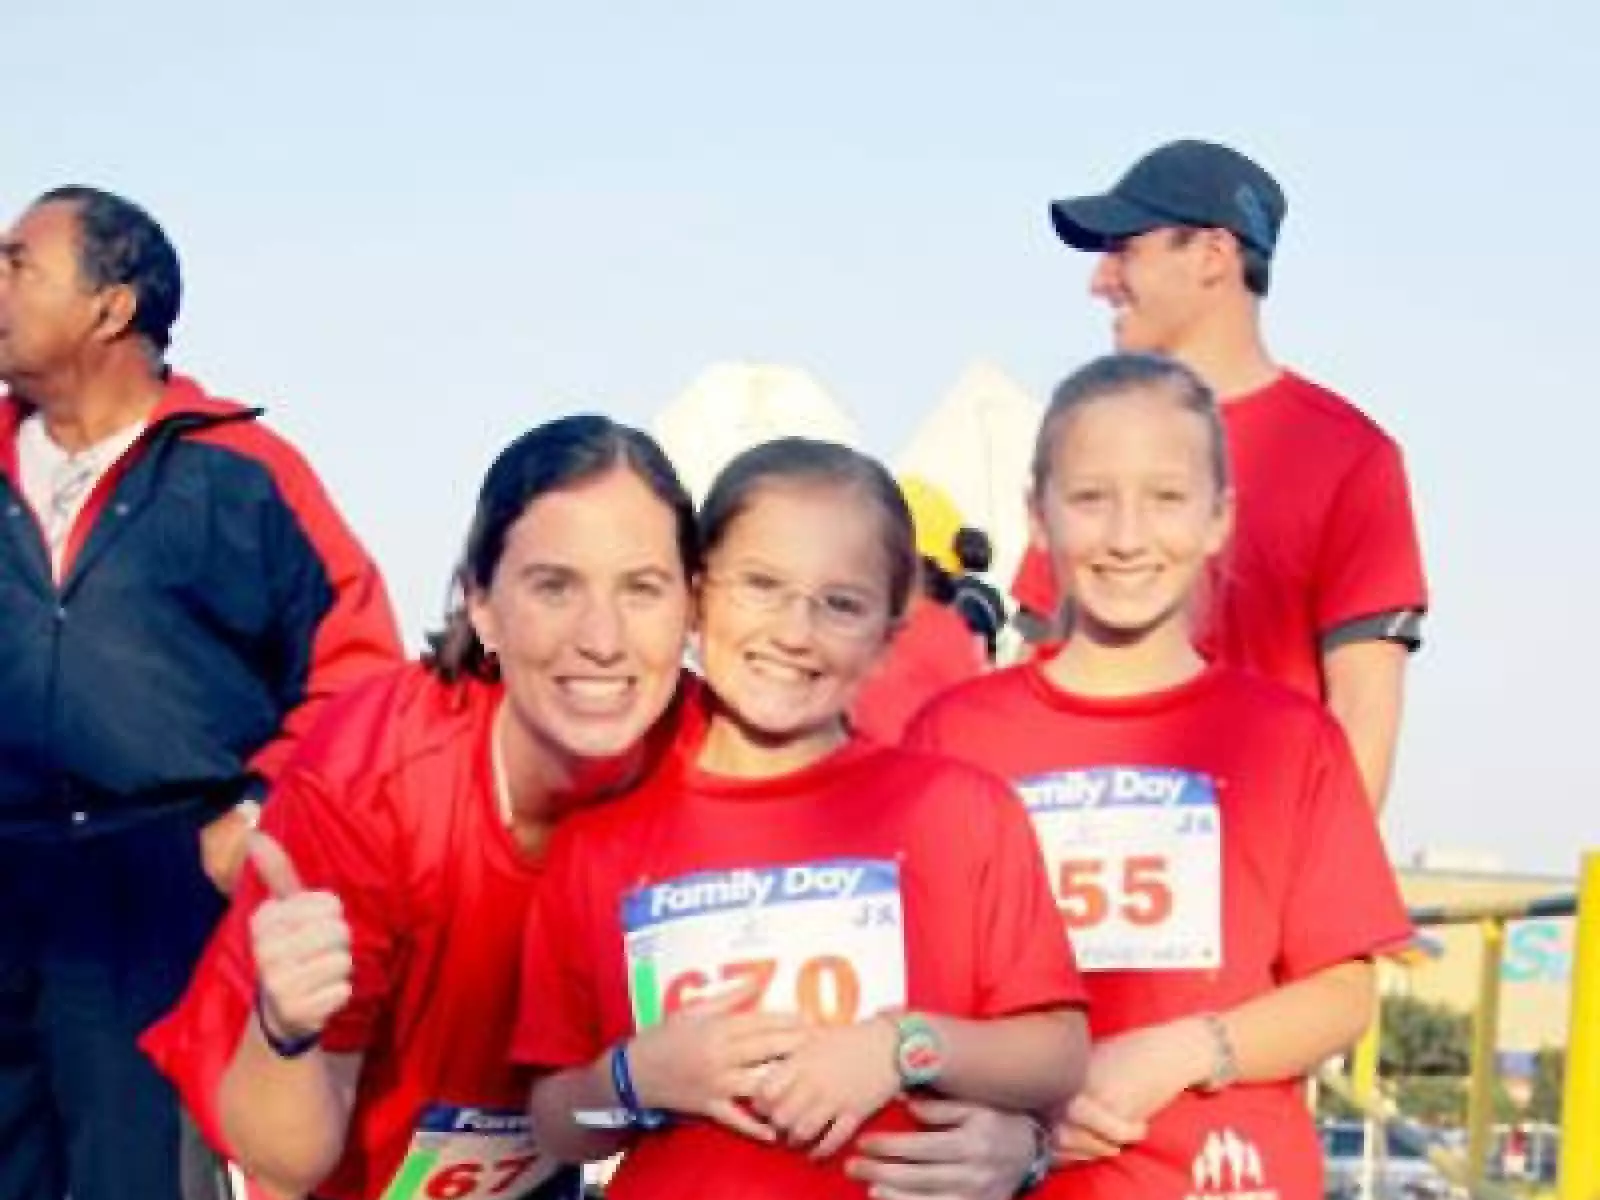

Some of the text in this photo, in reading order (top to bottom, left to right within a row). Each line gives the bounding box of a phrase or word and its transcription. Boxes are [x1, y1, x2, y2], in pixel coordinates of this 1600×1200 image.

[1115, 771, 1188, 806] Day
[650, 866, 865, 917] Family Day
